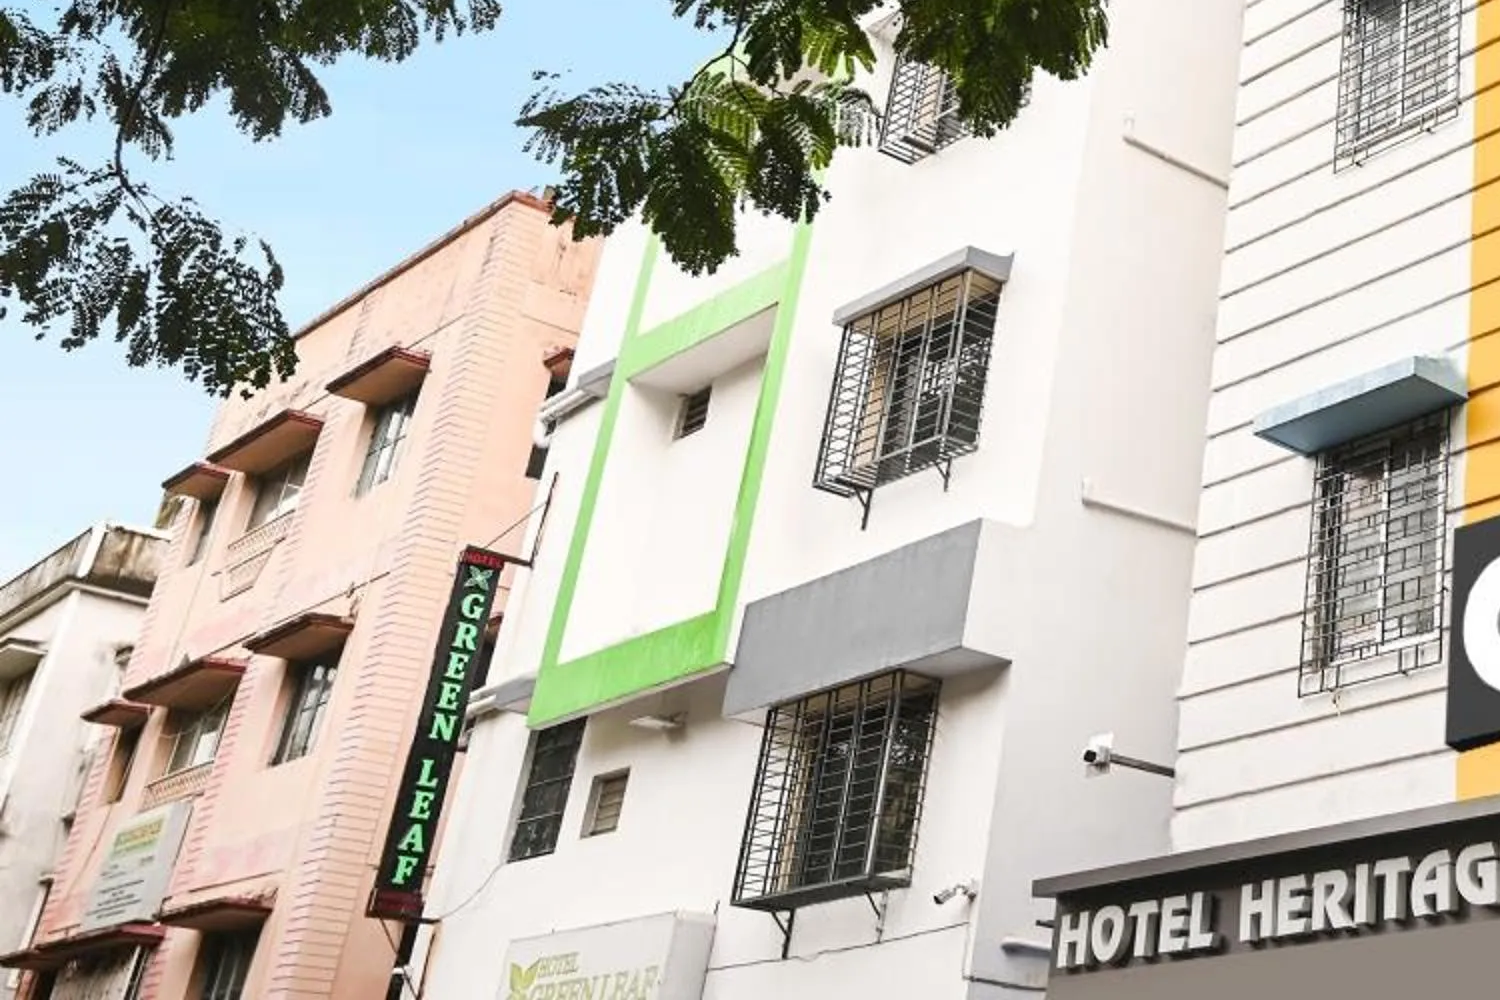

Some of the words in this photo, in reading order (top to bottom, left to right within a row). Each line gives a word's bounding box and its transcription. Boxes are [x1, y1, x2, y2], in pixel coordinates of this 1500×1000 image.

[429, 593, 487, 742] GREEN
[392, 759, 438, 885] LEAF
[537, 951, 580, 978] HOTEL
[1056, 890, 1216, 968] HOTEL
